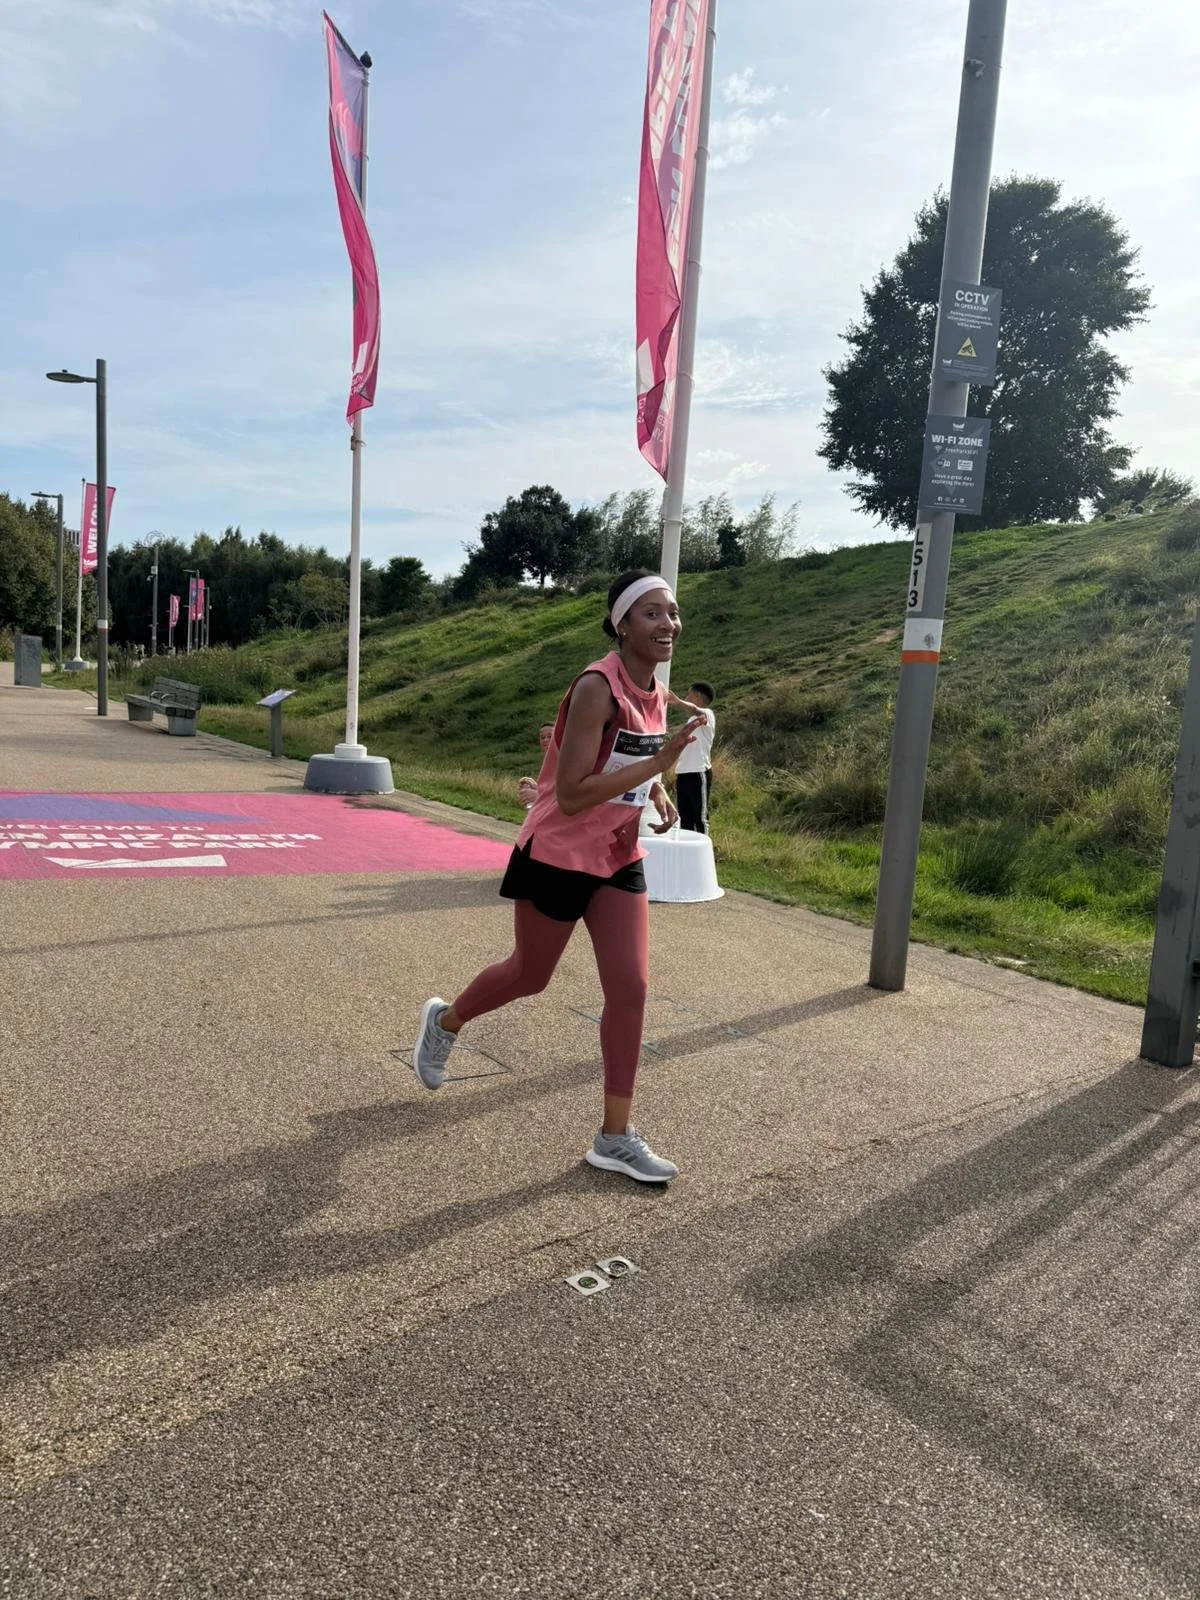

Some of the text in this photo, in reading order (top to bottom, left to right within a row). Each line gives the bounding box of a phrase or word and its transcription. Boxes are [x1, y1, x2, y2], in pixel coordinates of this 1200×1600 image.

[955, 289, 989, 306] CCTV
[965, 303, 989, 312] OPERATION
[931, 434, 983, 447] WI-FI ZONE
[908, 528, 924, 607] LS13
[58, 833, 324, 841] ELIZABETH
[168, 841, 307, 849] PARK
